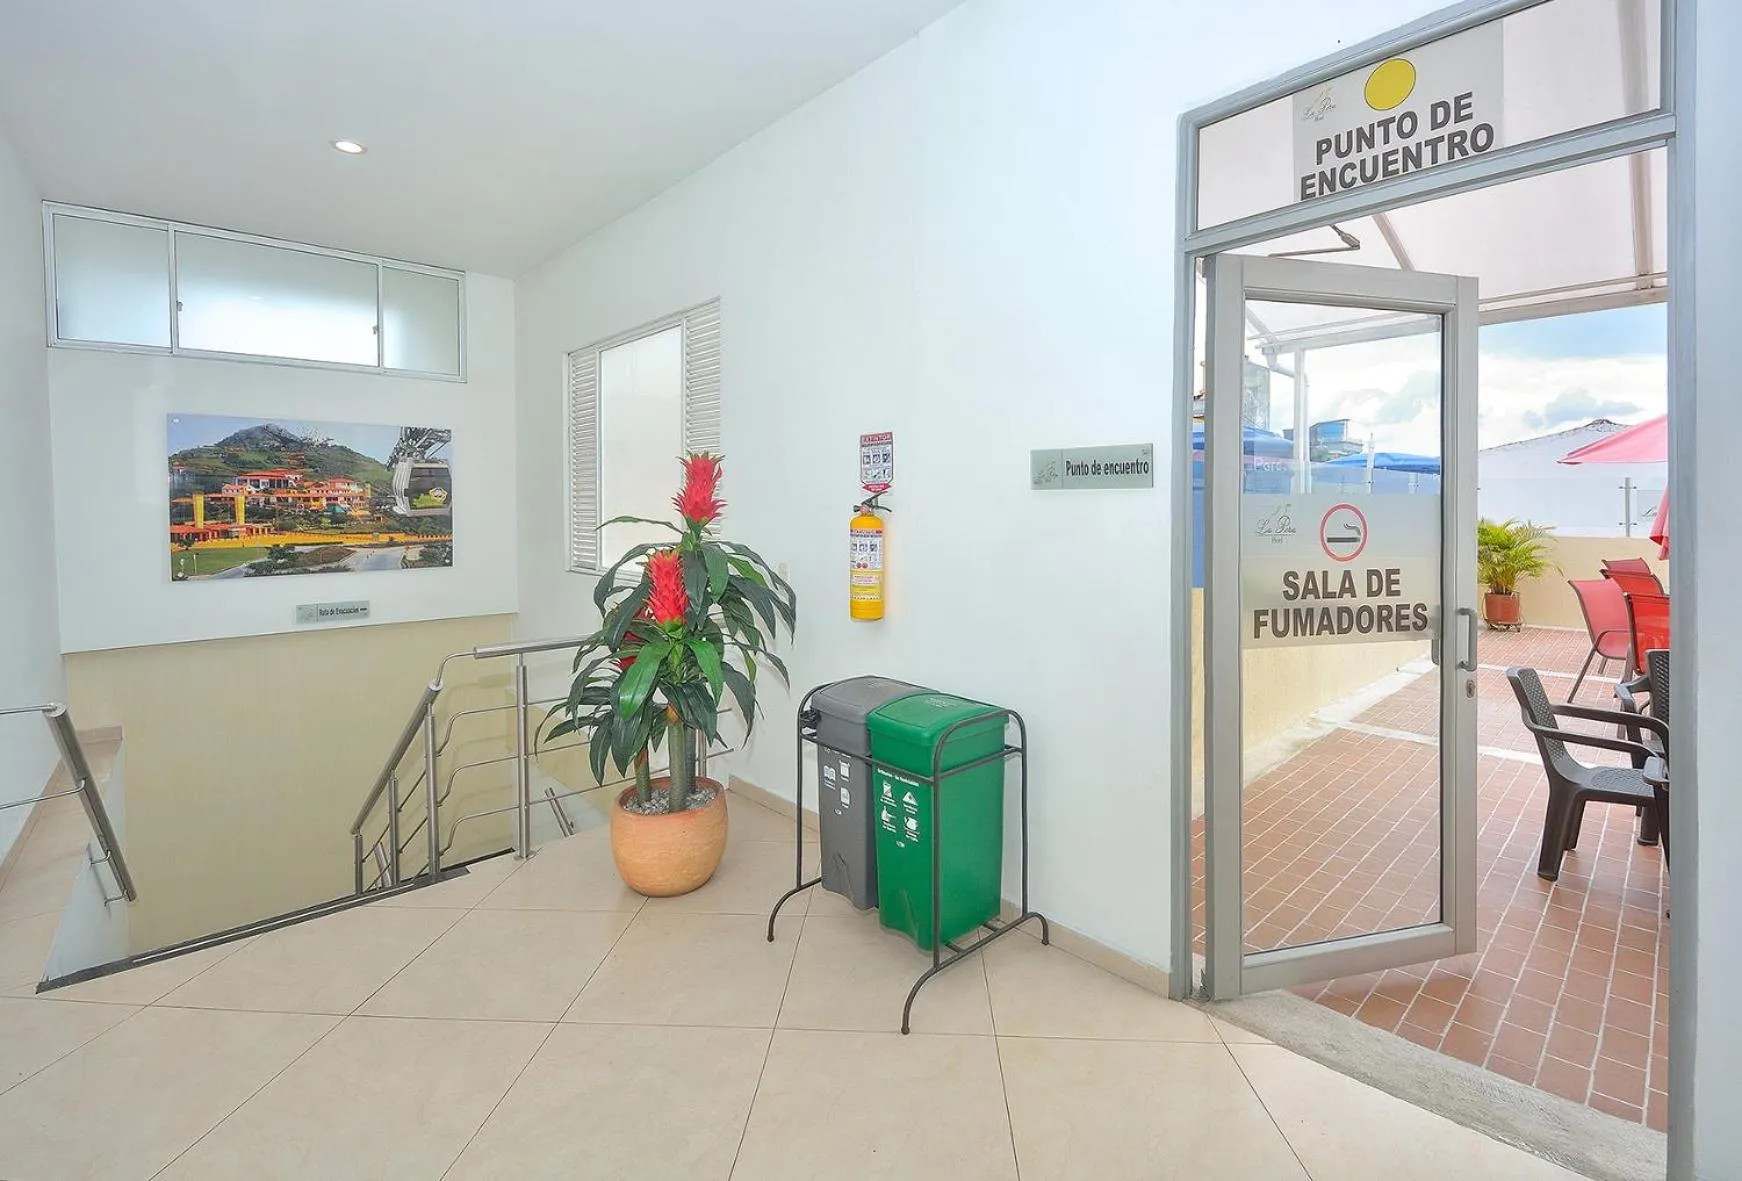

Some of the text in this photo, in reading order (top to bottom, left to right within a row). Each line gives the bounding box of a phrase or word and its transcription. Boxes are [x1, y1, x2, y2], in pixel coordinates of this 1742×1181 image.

[1316, 91, 1473, 165] PUNTO DE
[1301, 122, 1494, 201] ENCUENTRO
[1065, 460, 1089, 477] Punto
[1091, 459, 1102, 476] de
[1103, 458, 1150, 476] encuentro
[1282, 568, 1401, 601] SALA DE
[1253, 602, 1428, 639] FUMADORES
